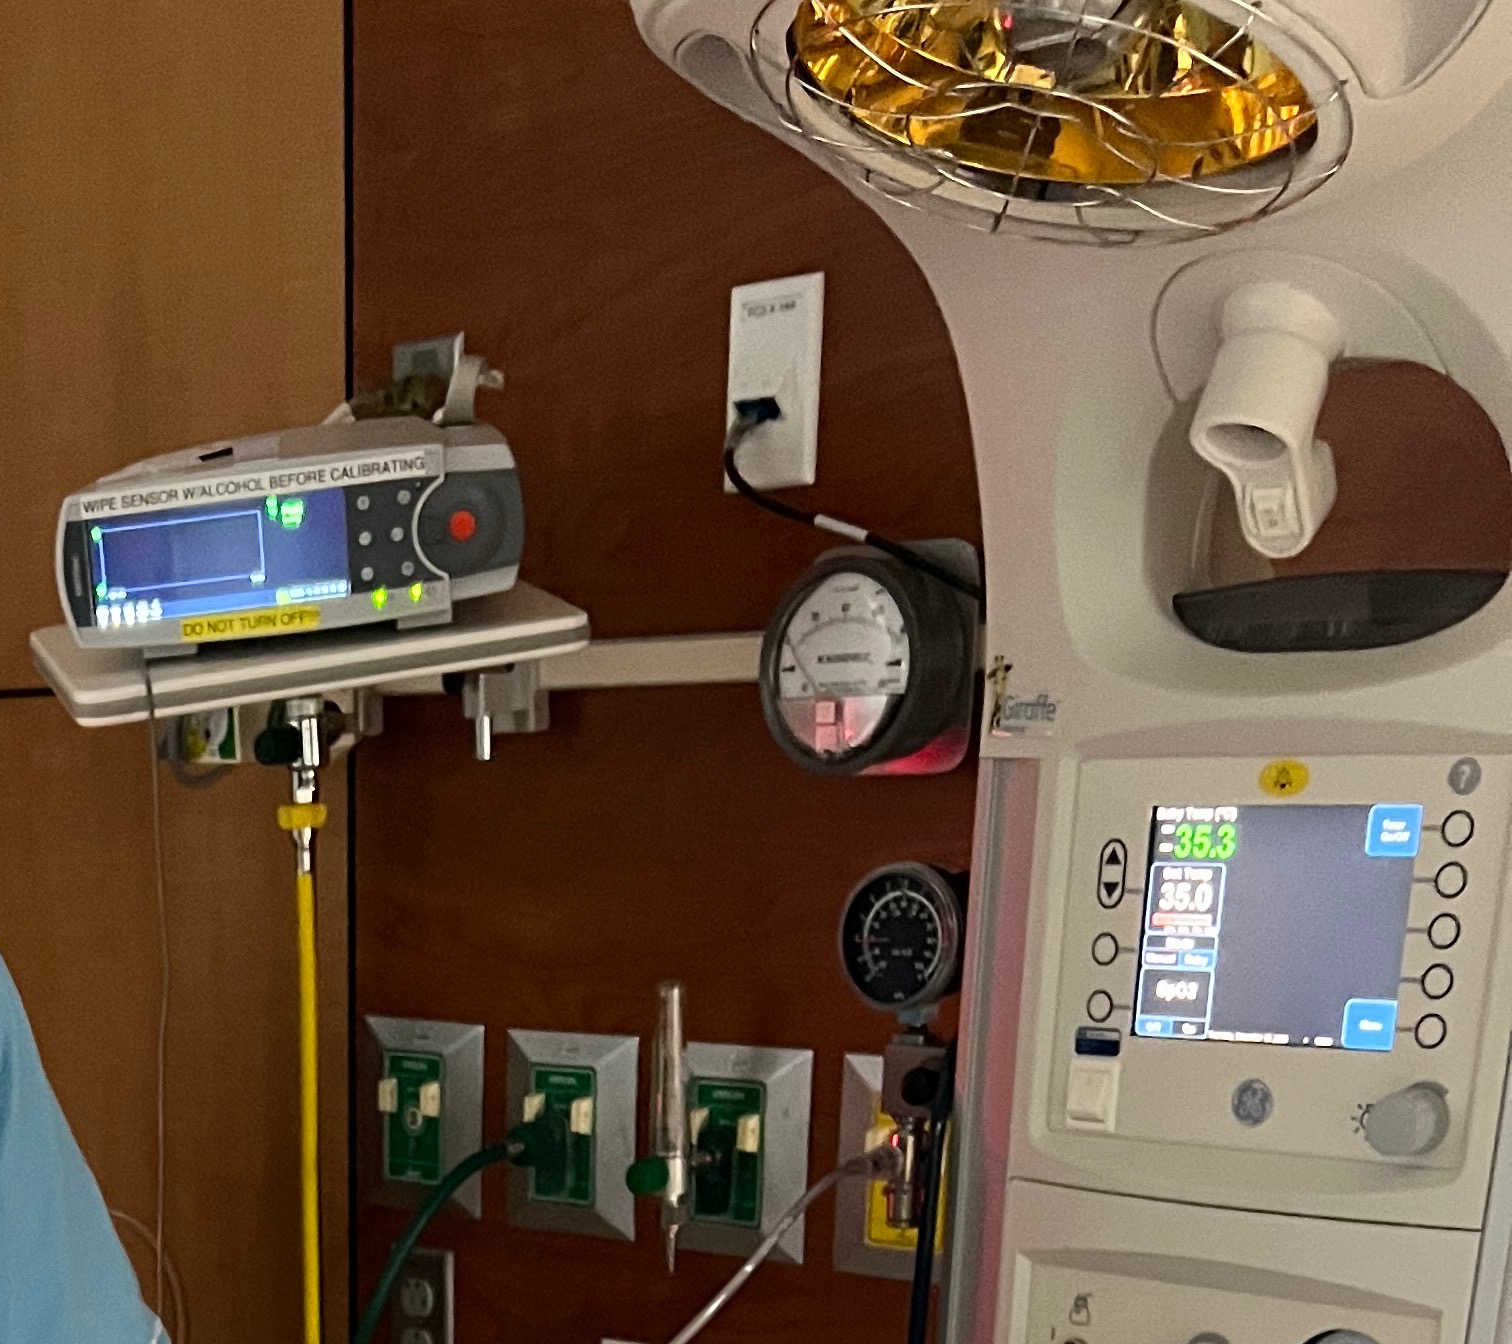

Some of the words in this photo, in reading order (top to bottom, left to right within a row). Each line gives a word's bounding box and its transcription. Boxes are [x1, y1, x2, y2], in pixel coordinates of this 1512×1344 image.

[83, 494, 119, 513] WIPE
[121, 488, 179, 510] SENSOR
[270, 467, 326, 489] BEFORE
[330, 456, 426, 482] CALIBRATING
[182, 622, 204, 638] DO
[206, 617, 234, 634] NOT
[239, 611, 278, 631] TURN
[1004, 693, 1056, 722] Giraffe
[1174, 824, 1237, 859] 35.3
[1158, 882, 1213, 911] 35.0
